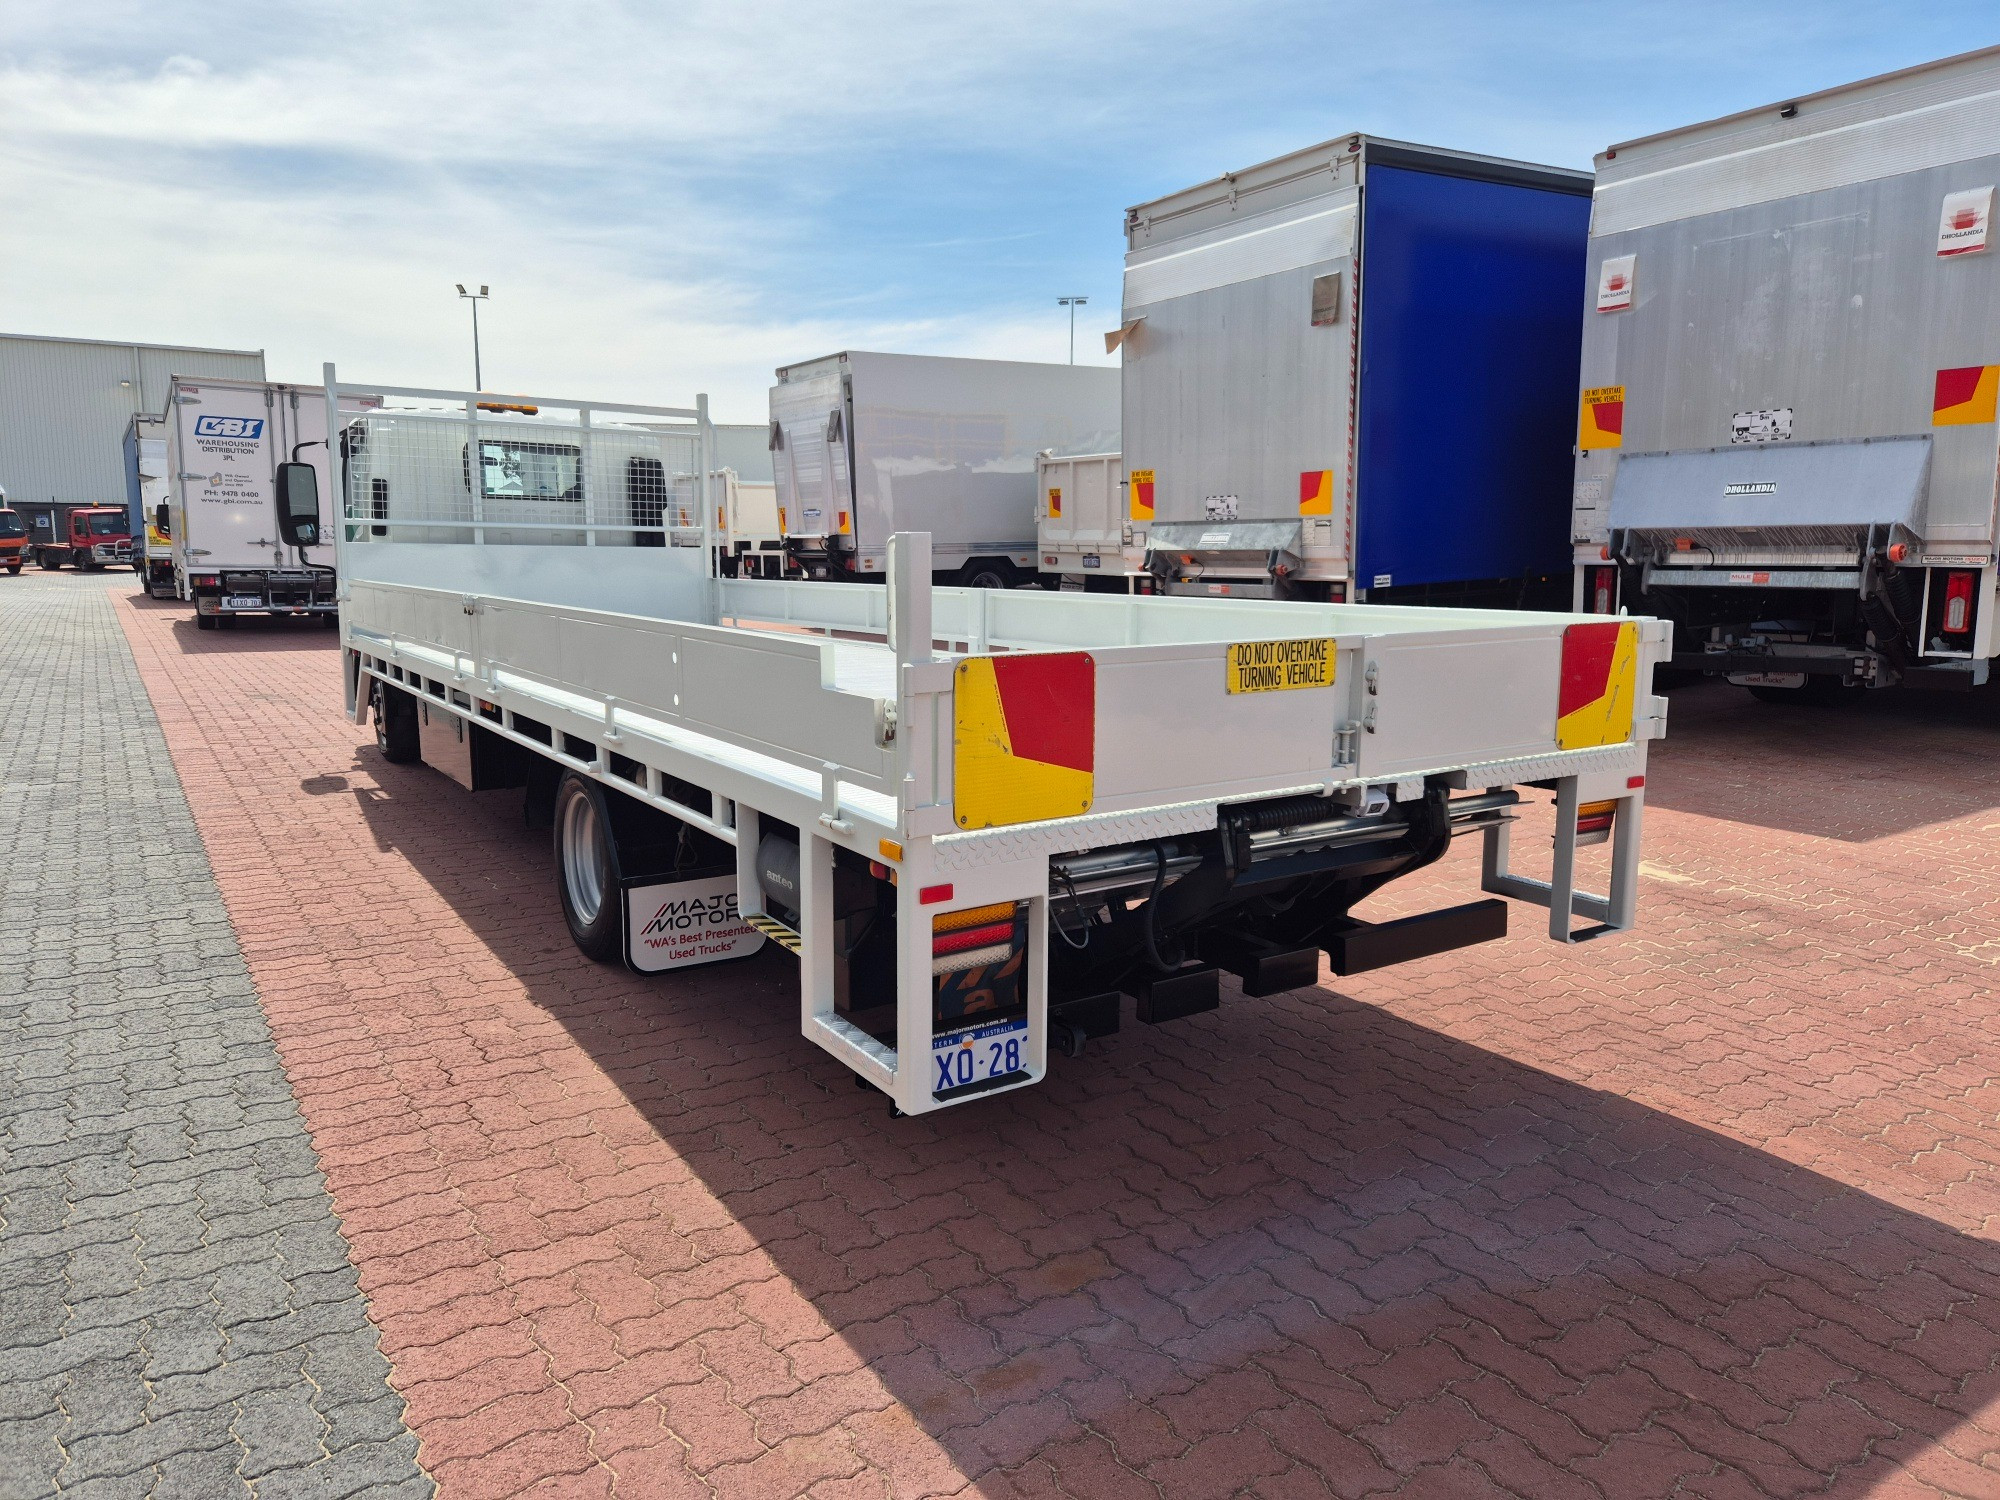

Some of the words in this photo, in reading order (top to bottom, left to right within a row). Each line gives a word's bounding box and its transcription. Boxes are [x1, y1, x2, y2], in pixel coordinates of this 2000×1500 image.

[1941, 228, 1984, 240] DHOLLANDIA
[197, 416, 262, 437] GBI
[196, 438, 260, 449] WAREHOUSING
[202, 446, 255, 455] DISTRIBUTION
[1725, 483, 1776, 494] DHOLLANDIA
[1237, 644, 1252, 666] DO
[1255, 642, 1275, 665] NOT
[1277, 639, 1328, 663] OVERTAKE
[1239, 665, 1282, 689] TURNING
[1286, 661, 1326, 685] VEHICLE
[766, 869, 793, 890] anteo
[659, 893, 738, 917] MAJO
[647, 908, 742, 935] MOTOR
[680, 931, 703, 945] Best
[669, 946, 696, 960] Used
[933, 1038, 953, 1049] TERN
[981, 1024, 1014, 1038] AUSTRALIA
